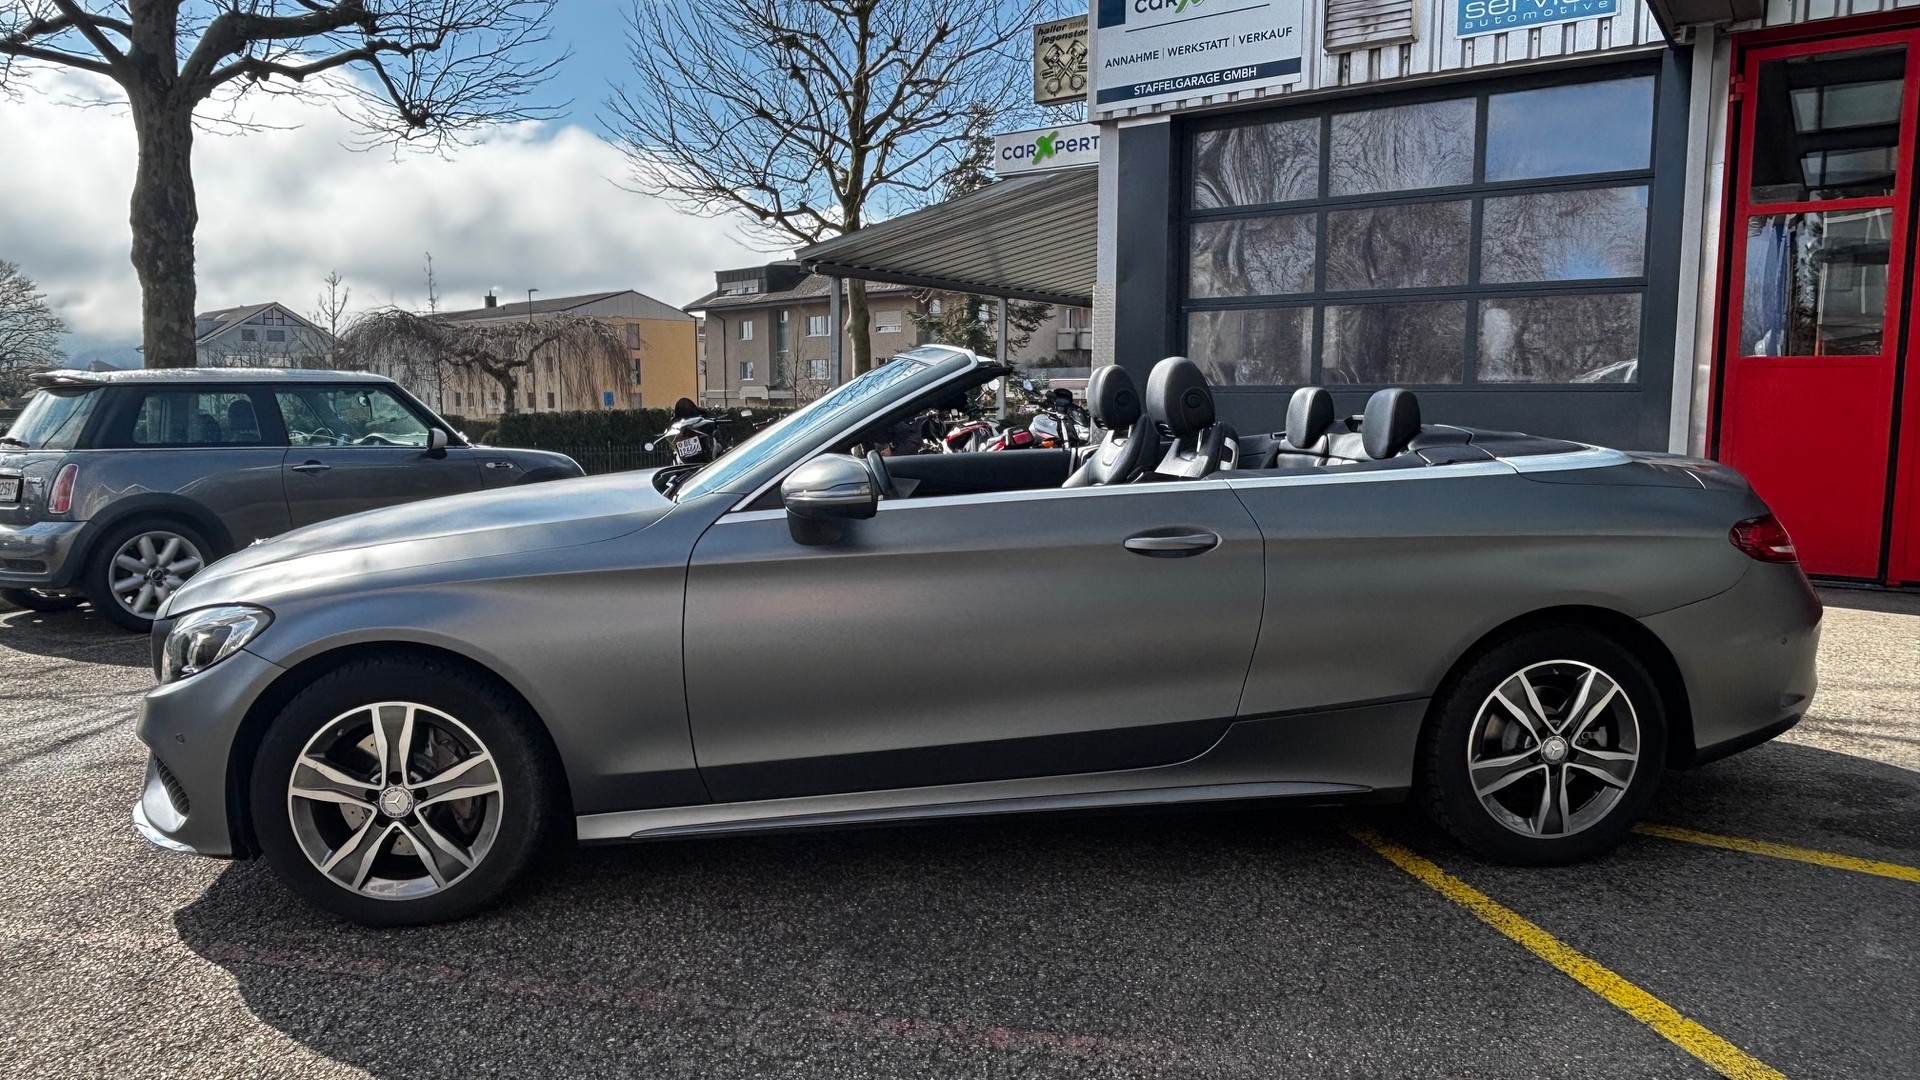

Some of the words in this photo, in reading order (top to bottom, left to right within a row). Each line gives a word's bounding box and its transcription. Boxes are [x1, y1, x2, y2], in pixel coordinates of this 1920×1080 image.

[1465, 0, 1608, 29] automotive
[1105, 50, 1159, 68] ANNAHME
[1167, 37, 1230, 57] WERKSTATT
[1239, 26, 1293, 45] VERKAUF
[1134, 72, 1220, 95] STAFFELGARAGE
[1223, 66, 1257, 81] GMBH
